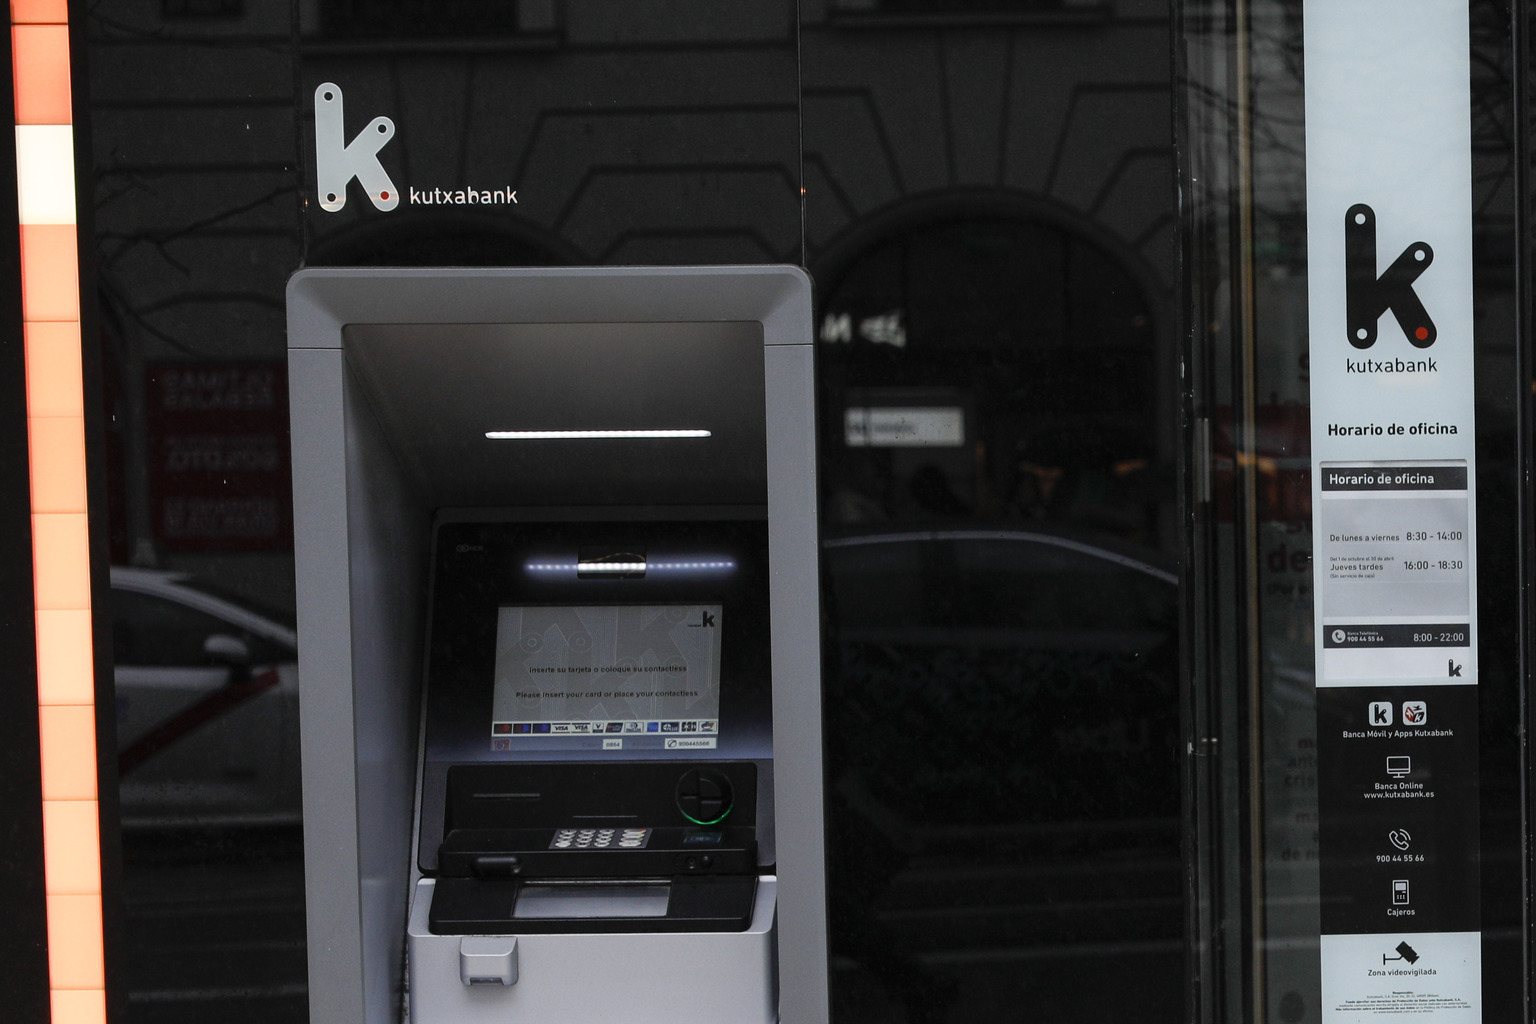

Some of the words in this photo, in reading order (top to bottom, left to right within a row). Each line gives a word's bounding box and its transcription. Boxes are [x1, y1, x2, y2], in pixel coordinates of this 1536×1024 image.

[410, 186, 518, 204] kutxabank
[1347, 357, 1437, 373] kutxabank
[1328, 423, 1383, 436] Horario
[1387, 423, 1405, 435] de
[1409, 422, 1458, 435] oficina
[1329, 473, 1374, 485] Horario
[1377, 473, 1392, 484] de
[1395, 473, 1434, 484] oficina
[1330, 534, 1340, 542] De
[1342, 534, 1363, 542] lunes
[1406, 531, 1427, 541] 8:30
[1437, 531, 1462, 541] 14:00
[1330, 563, 1357, 571] Jueves
[1359, 563, 1384, 571] tardes
[1404, 560, 1429, 570] 16:00
[1438, 560, 1463, 570] 18:30
[1413, 633, 1432, 642] 8:00
[1440, 632, 1464, 642] 22:00
[1343, 730, 1365, 738] Banca
[1367, 730, 1387, 738] Móvil
[1394, 730, 1413, 738] Apps
[1414, 729, 1453, 737] Kutxabank
[1375, 782, 1398, 790] Banca
[1363, 790, 1435, 799] www.kutxabank.es
[1403, 854, 1413, 862] 55
[1415, 854, 1424, 862] 66
[1387, 908, 1415, 917] Cajeros
[1387, 968, 1437, 977] videovigilada
